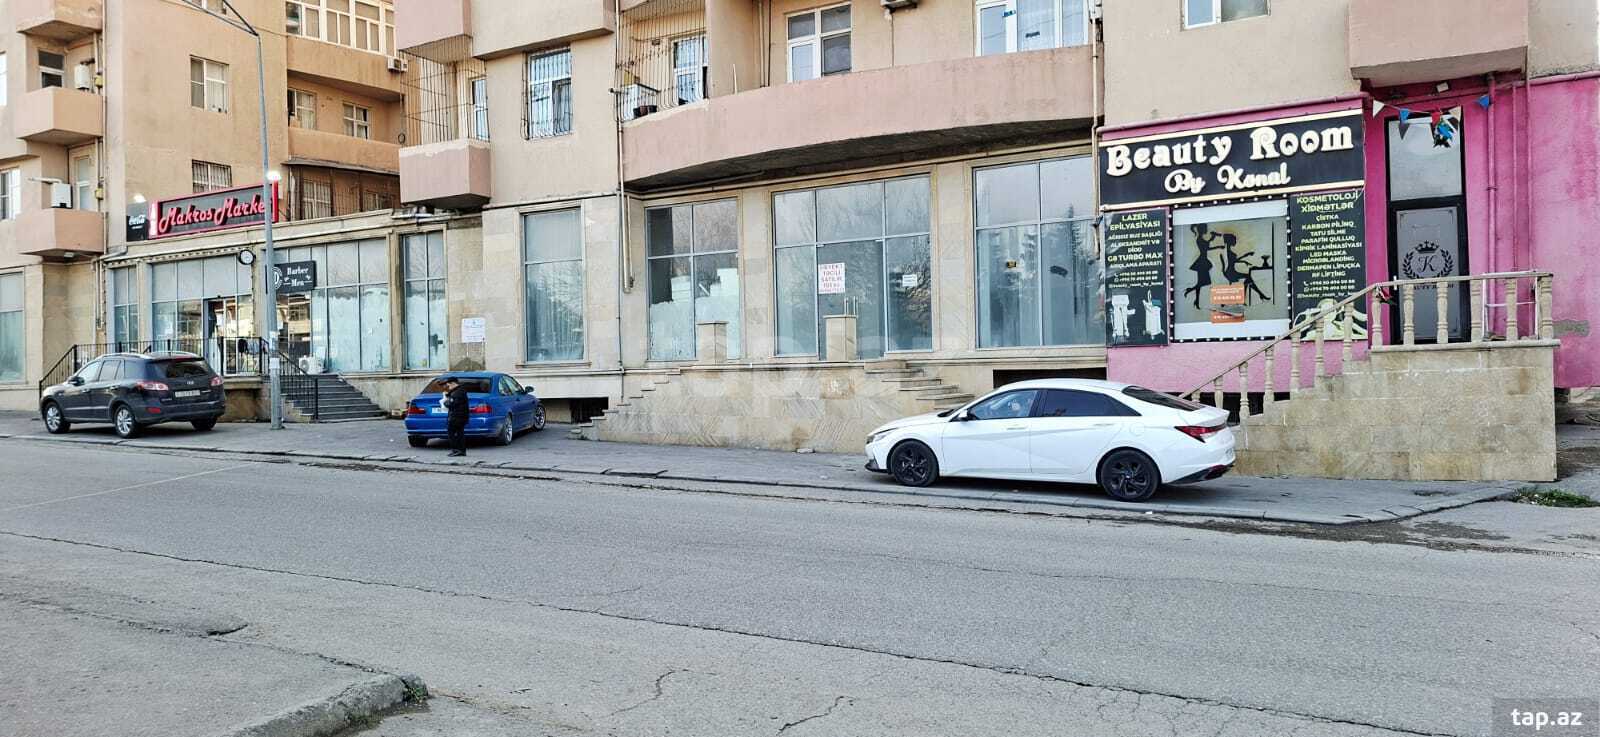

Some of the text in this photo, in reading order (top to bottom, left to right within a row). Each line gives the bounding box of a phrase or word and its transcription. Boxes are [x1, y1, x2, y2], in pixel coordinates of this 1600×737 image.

[1106, 126, 1354, 176] Beauty Room
[1164, 168, 1206, 194] By
[158, 193, 266, 233] Makros Marke
[1122, 213, 1147, 221] LAZER
[1110, 220, 1160, 231] EPİLYASİYASI
[1301, 222, 1330, 230] KARBON
[1118, 253, 1144, 261] TURBO
[1145, 251, 1163, 259] MAX
[1416, 254, 1438, 273] K
